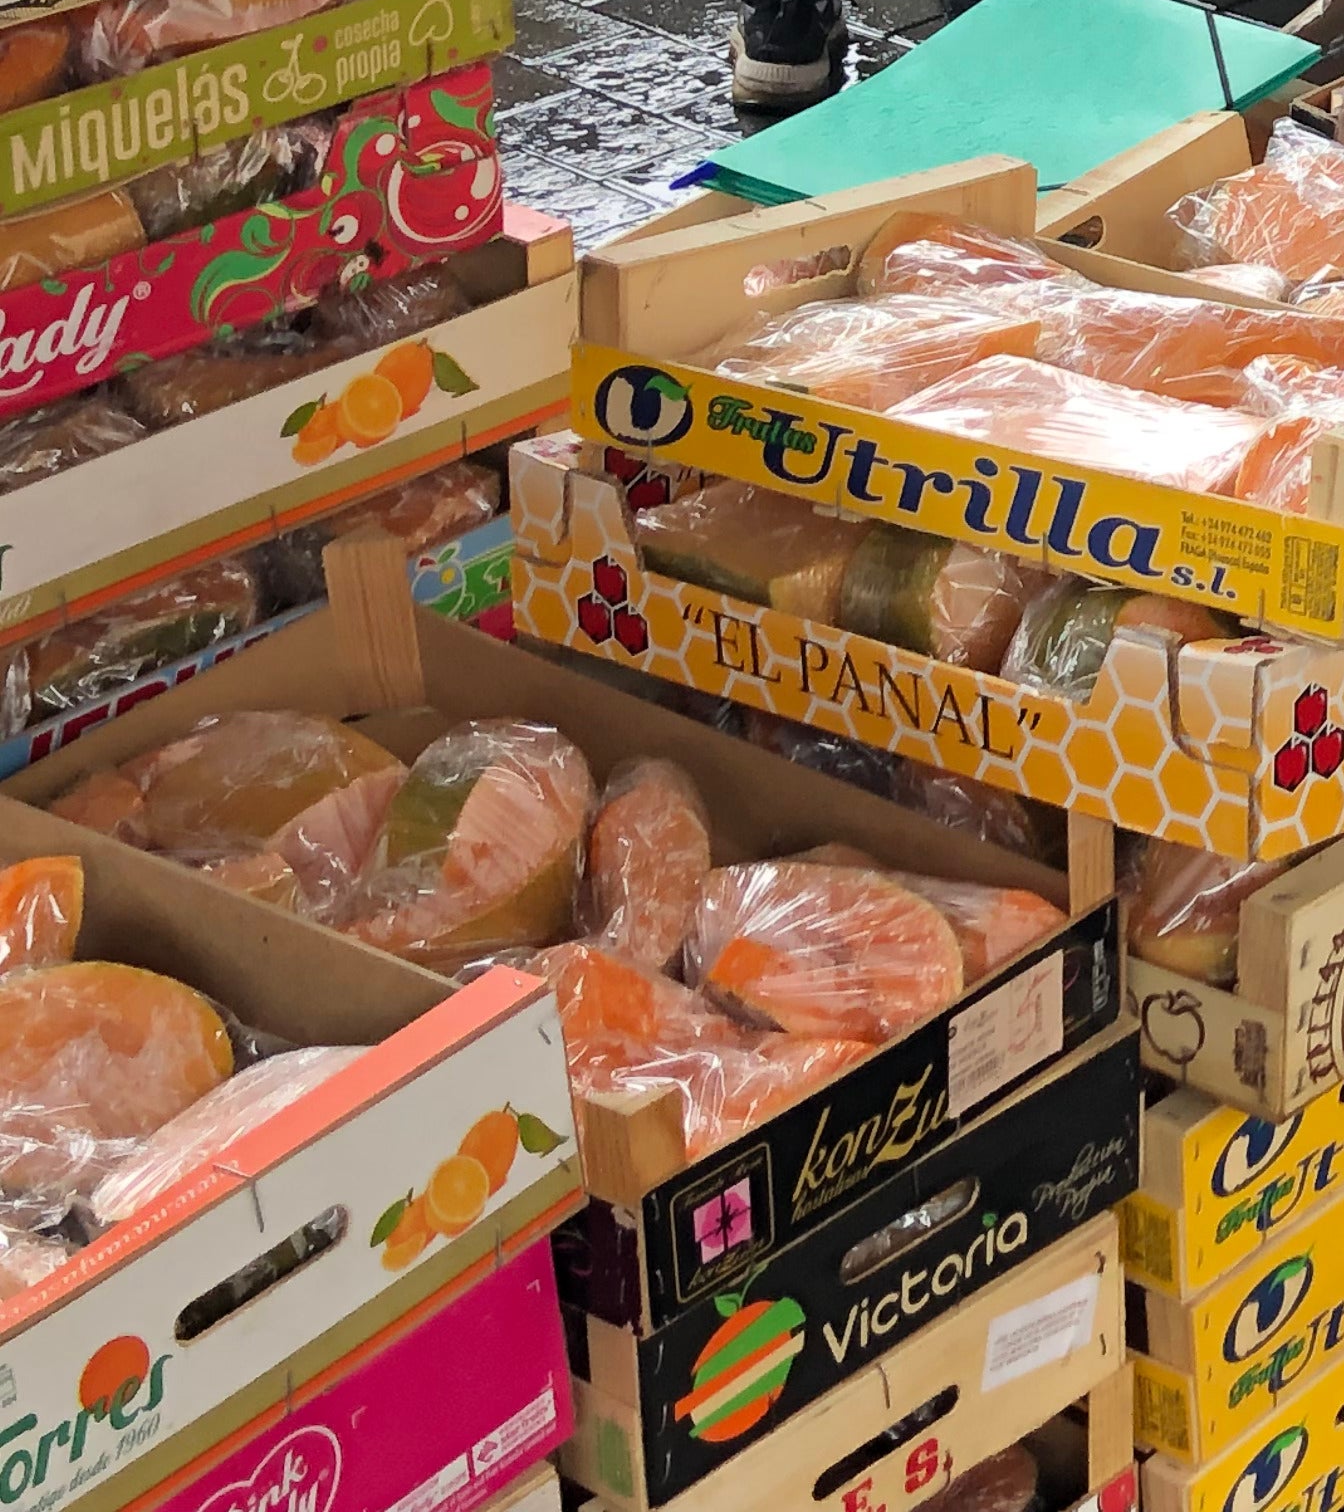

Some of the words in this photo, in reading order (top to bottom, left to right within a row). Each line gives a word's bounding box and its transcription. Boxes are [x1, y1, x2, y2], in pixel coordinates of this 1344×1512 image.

[335, 8, 400, 50] cosecha
[336, 36, 400, 95] propia
[11, 62, 249, 194] Miquelás
[707, 394, 817, 455] Frutas
[761, 407, 1166, 578] Utrilla
[1170, 565, 1238, 599] s.l.
[822, 1210, 1028, 1364] Victoria
